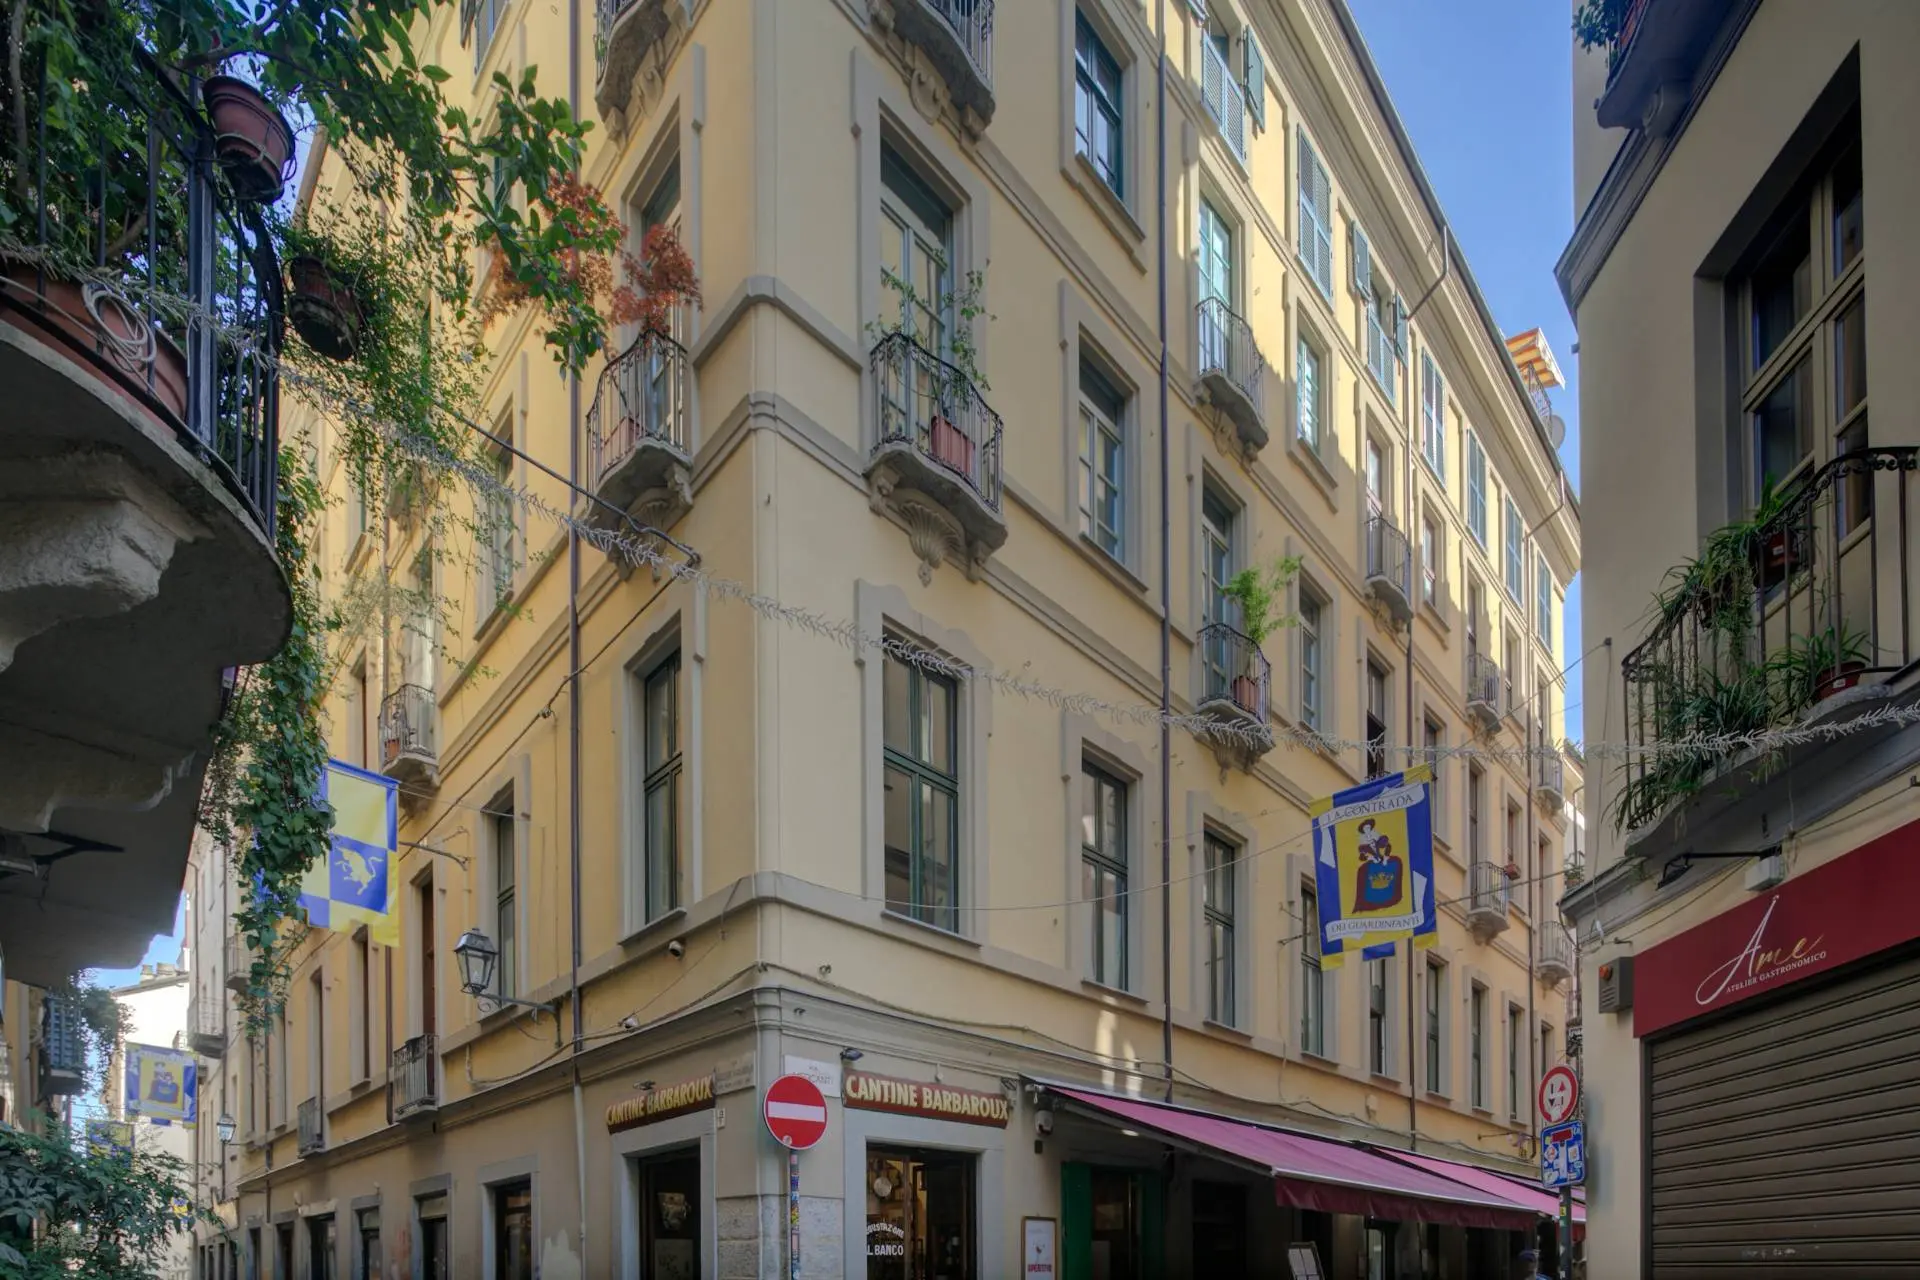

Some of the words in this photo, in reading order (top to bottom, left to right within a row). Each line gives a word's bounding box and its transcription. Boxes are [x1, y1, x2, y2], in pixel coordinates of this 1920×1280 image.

[1327, 810, 1342, 821] LA
[1344, 795, 1414, 816] CONTRADA
[1726, 976, 1758, 994] ATELIER
[1759, 951, 1827, 981] GASTRONOMICO
[605, 1096, 645, 1126] CANTINE
[646, 1075, 712, 1115] BARBAROUX
[845, 1075, 918, 1108] CANTINE
[922, 1088, 1009, 1121] BARBAROUX
[867, 1222, 905, 1239] GUSTAZIONE
[874, 1244, 904, 1256] BANCO
